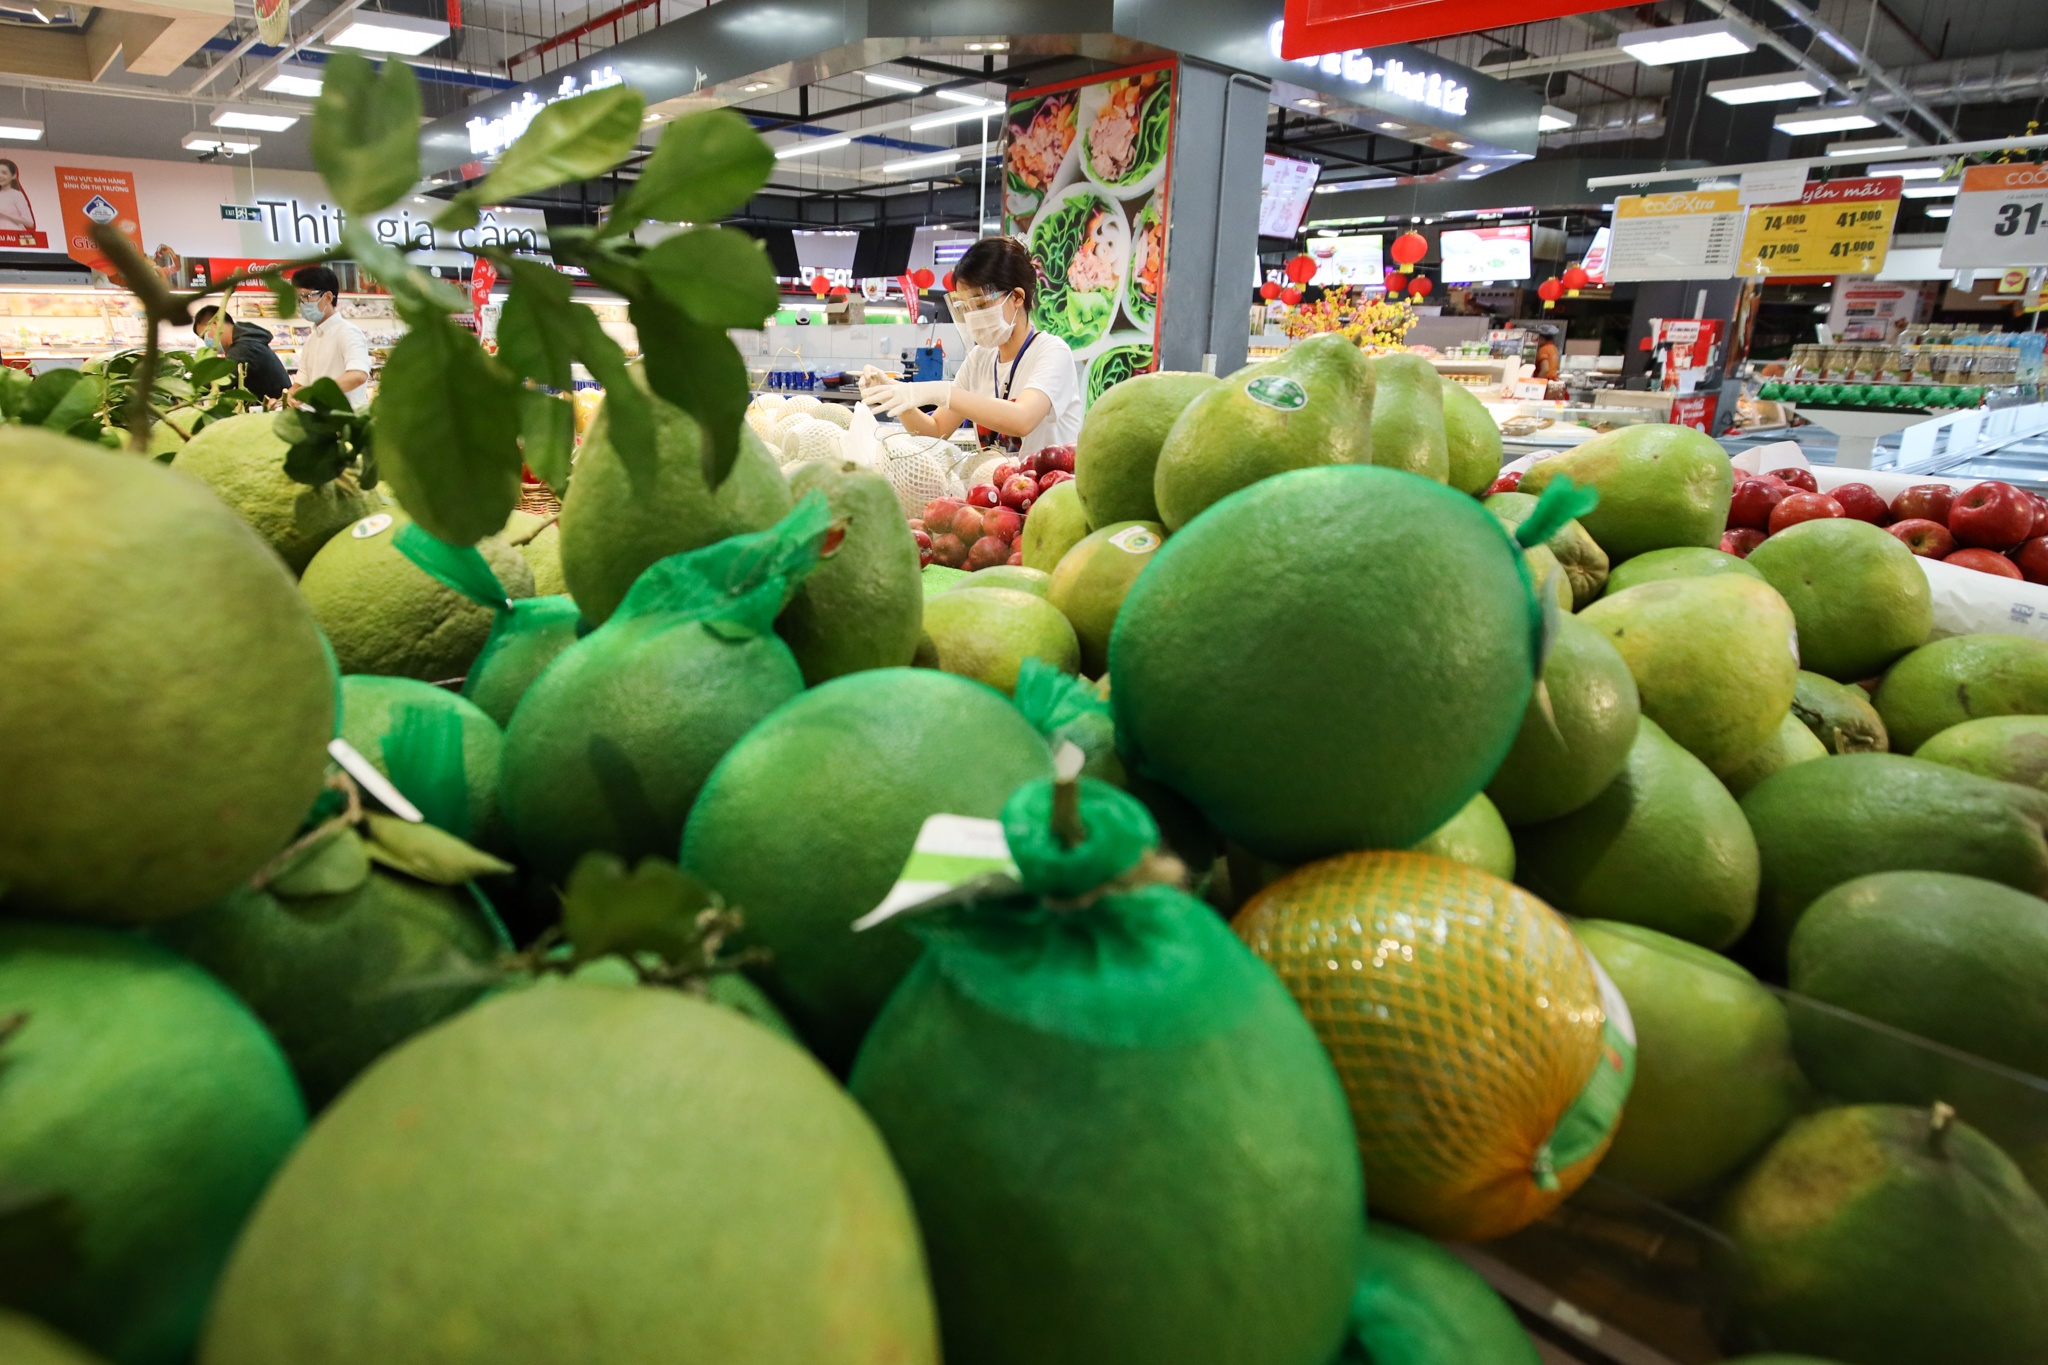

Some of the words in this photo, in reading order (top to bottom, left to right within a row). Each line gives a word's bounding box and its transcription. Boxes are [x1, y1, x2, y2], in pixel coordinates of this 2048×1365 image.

[1384, 59, 1427, 102] Heat
[1426, 73, 1441, 108] &
[1441, 80, 1469, 116] Eat
[1843, 182, 1886, 197] mãi
[256, 199, 347, 255] Thịt
[376, 210, 436, 254] gia
[1764, 213, 1806, 231] 74.000
[1836, 210, 1882, 228] 41.000
[1758, 243, 1800, 260] 47.000
[1830, 240, 1875, 257] 41.000
